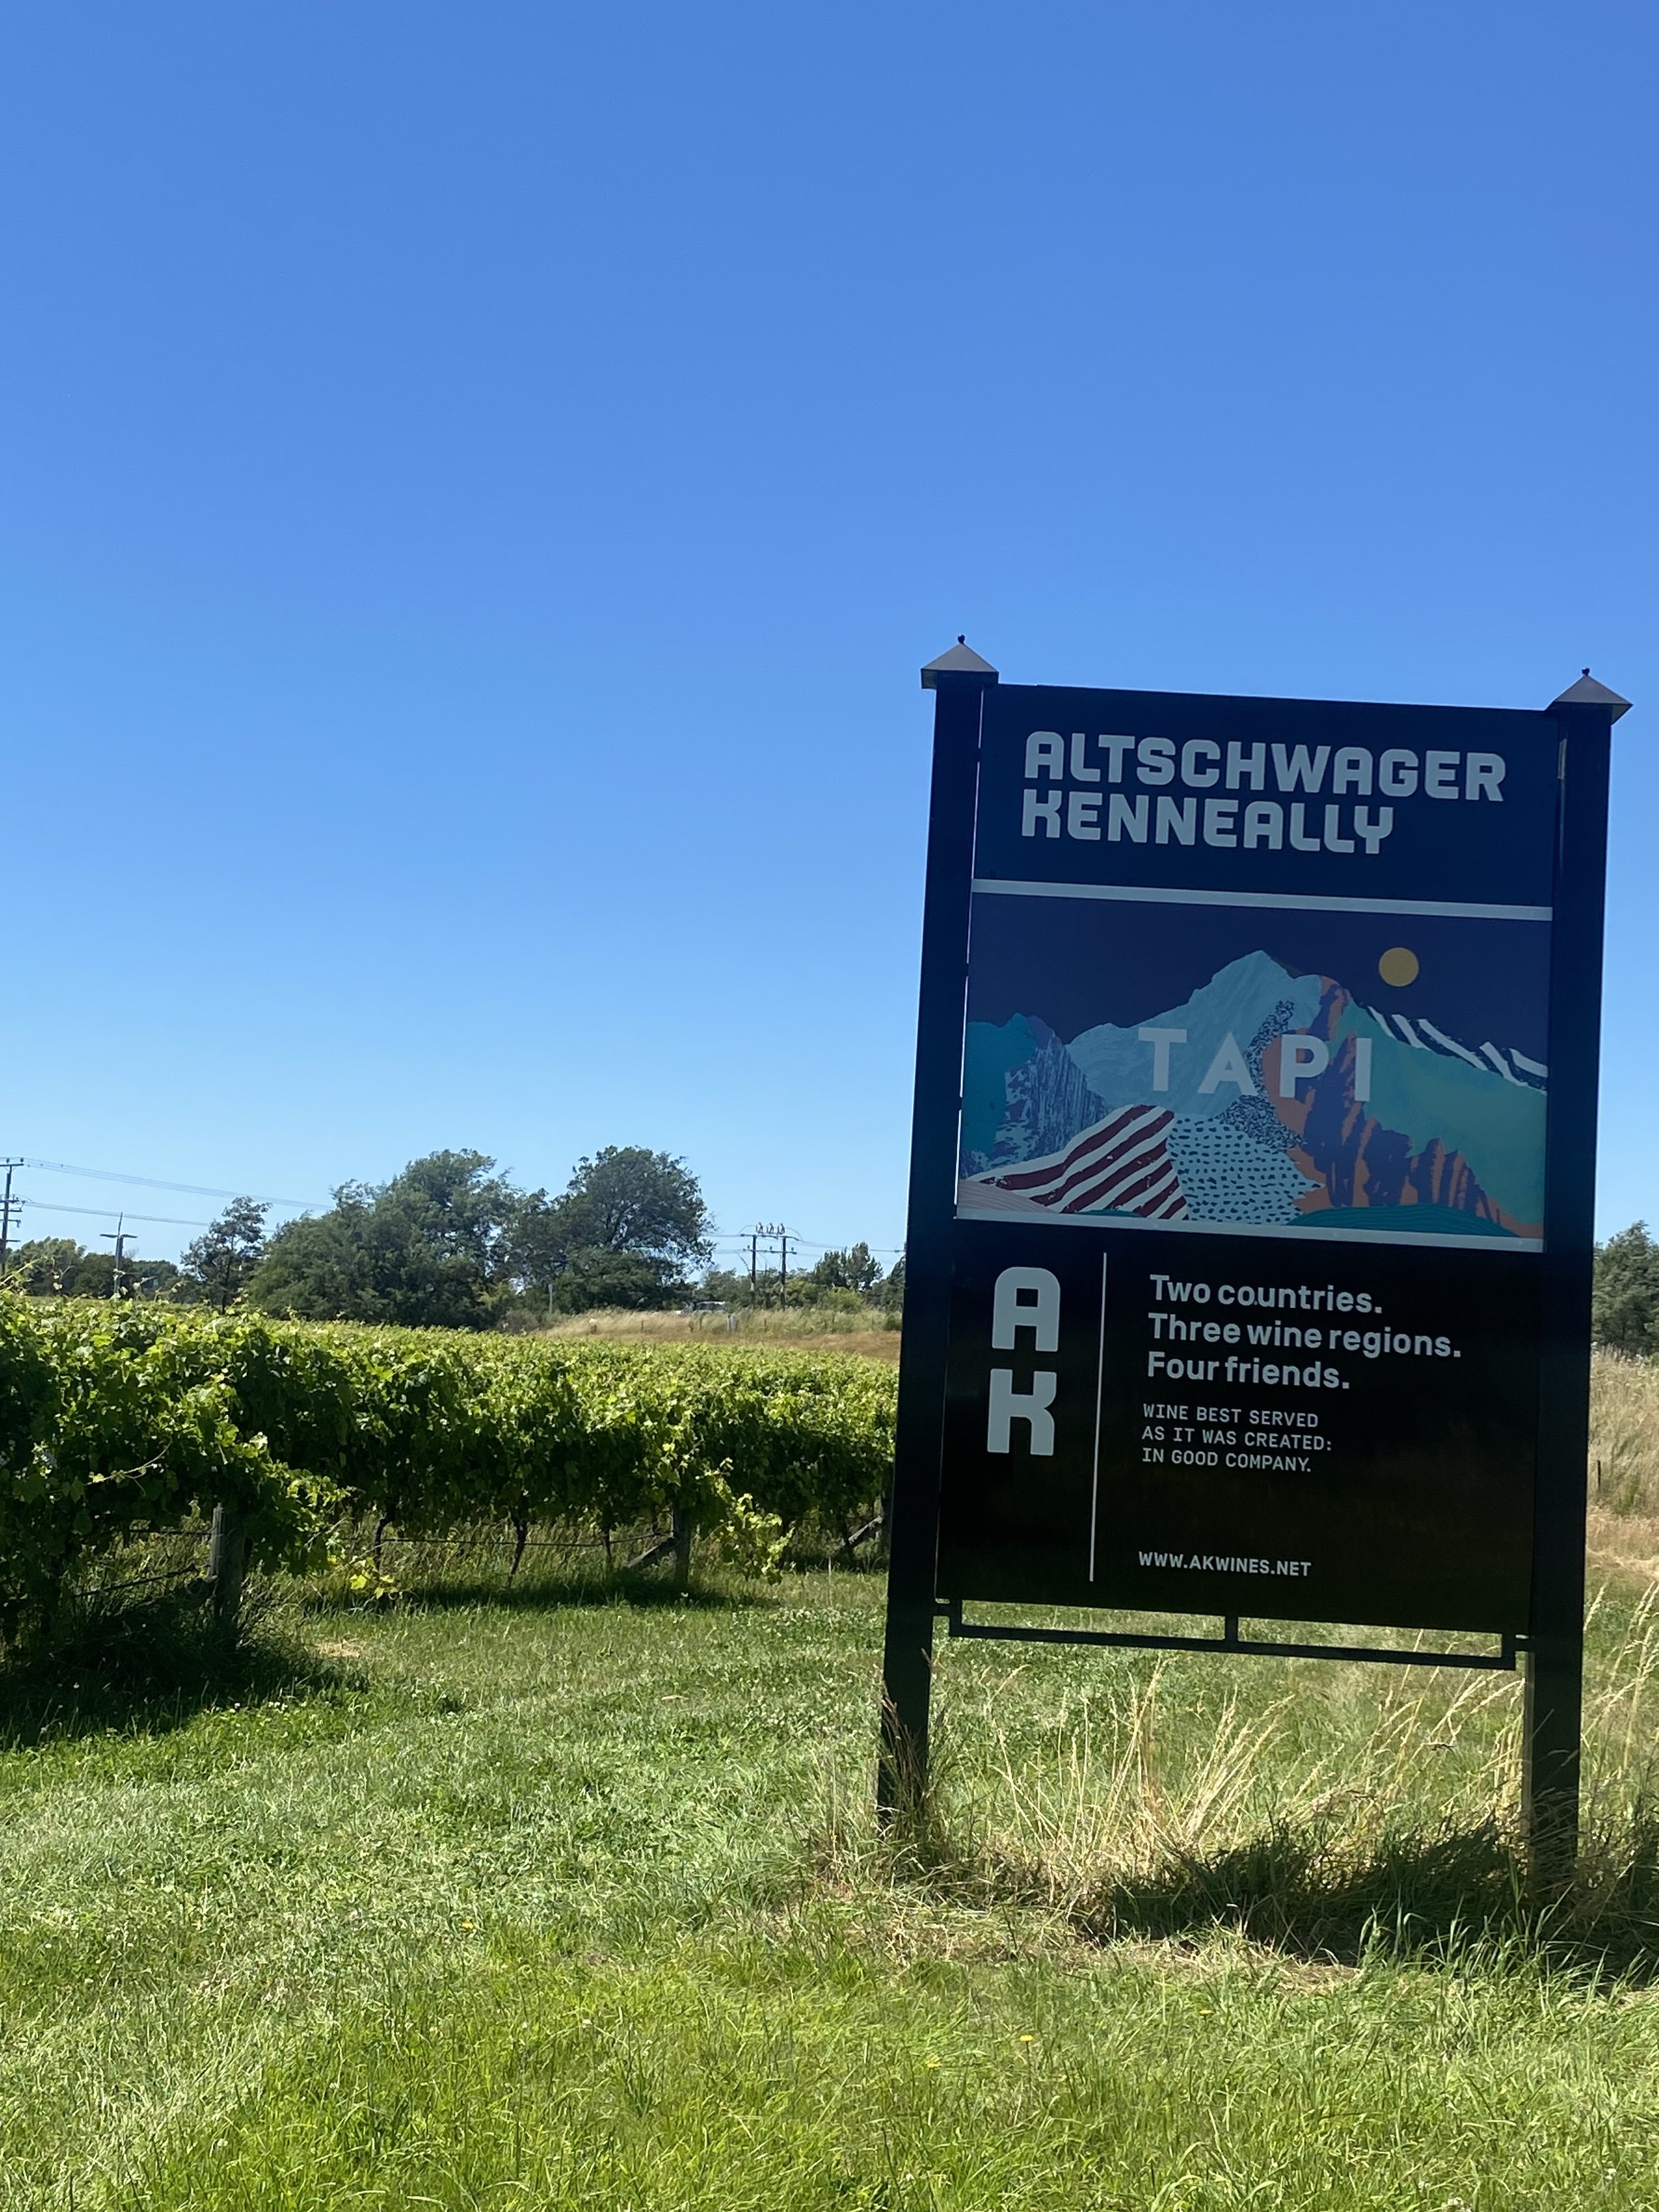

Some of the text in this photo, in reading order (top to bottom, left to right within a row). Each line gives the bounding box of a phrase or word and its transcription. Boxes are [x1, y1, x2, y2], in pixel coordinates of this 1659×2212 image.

[1025, 731, 1506, 802] ALTSCHWAGER
[1021, 788, 1394, 854] KENNEALLY
[1137, 1027, 1372, 1102] TAPI
[1149, 1274, 1382, 1314] Two countries.
[1148, 1312, 1461, 1359] Three wine regions.
[1147, 1351, 1350, 1389] Four friends.
[1143, 1403, 1318, 1428] WINE BEST SERVED
[1141, 1426, 1331, 1451] AS IT WAS CREATED:
[1142, 1447, 1311, 1472] IN GOOD COMPANY.
[1138, 1551, 1312, 1576] WWW.AKWINES.NET
